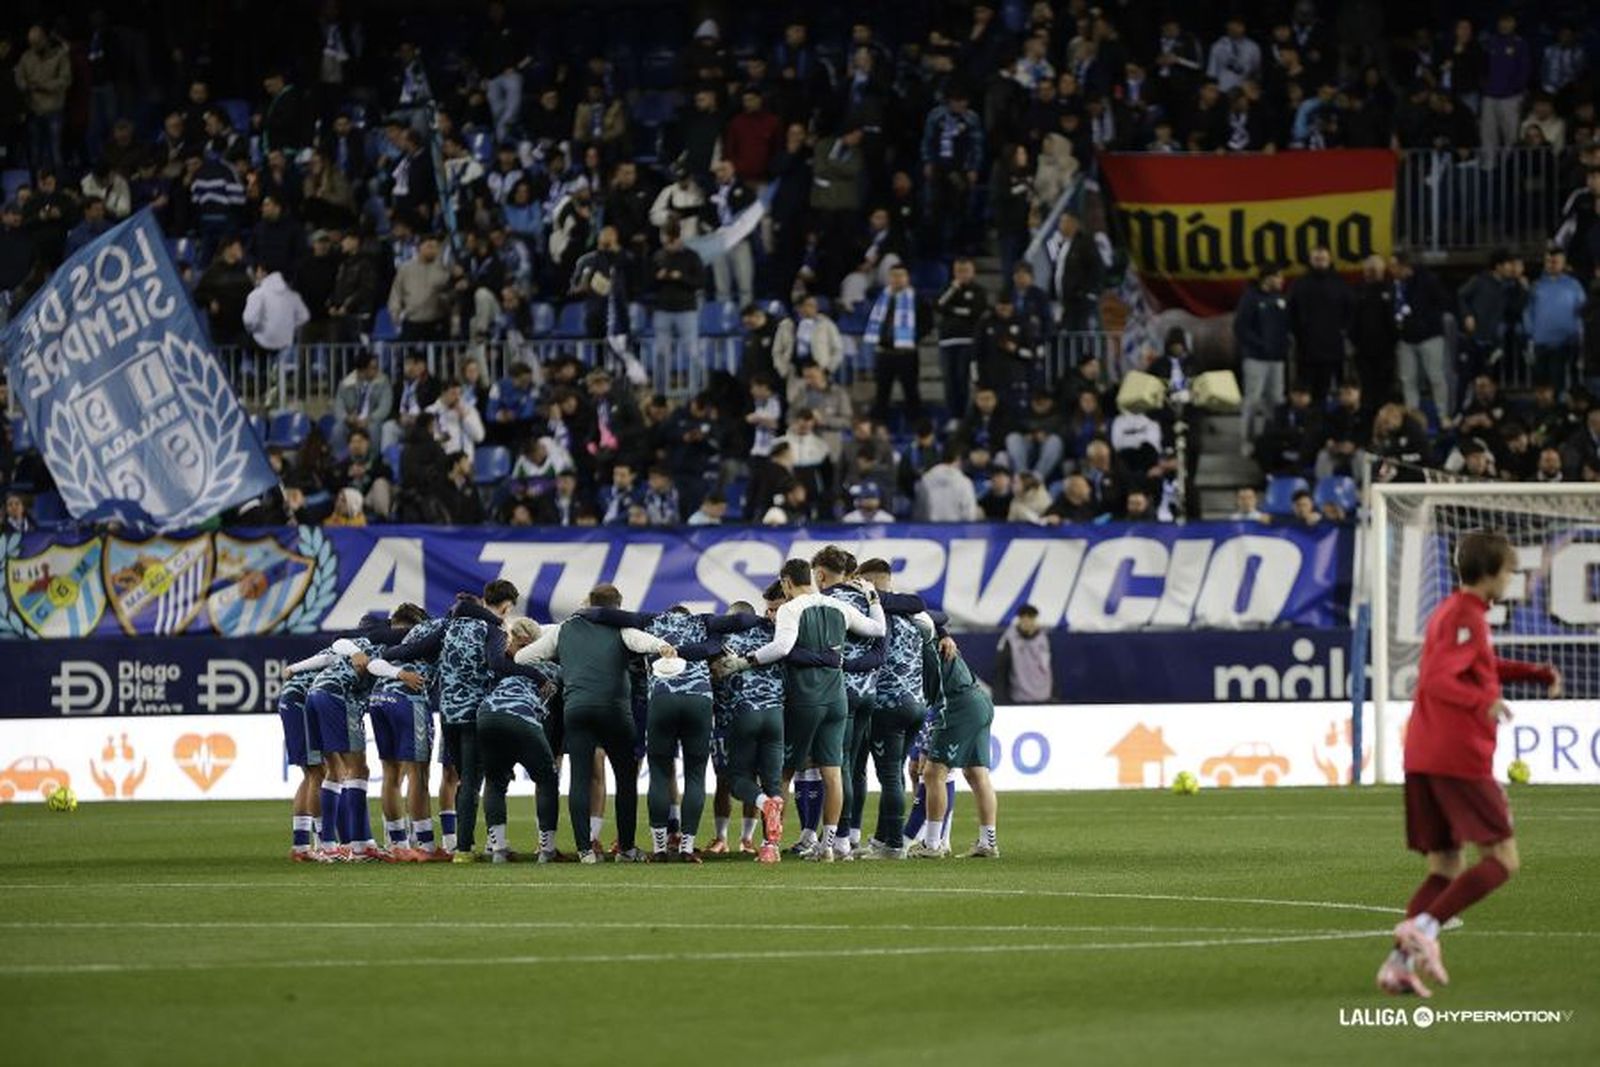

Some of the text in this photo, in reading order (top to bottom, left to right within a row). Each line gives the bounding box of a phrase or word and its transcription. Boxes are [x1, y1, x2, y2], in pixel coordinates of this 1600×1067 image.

[321, 536, 427, 631] A
[478, 541, 664, 625] TU
[118, 660, 181, 683] Diego
